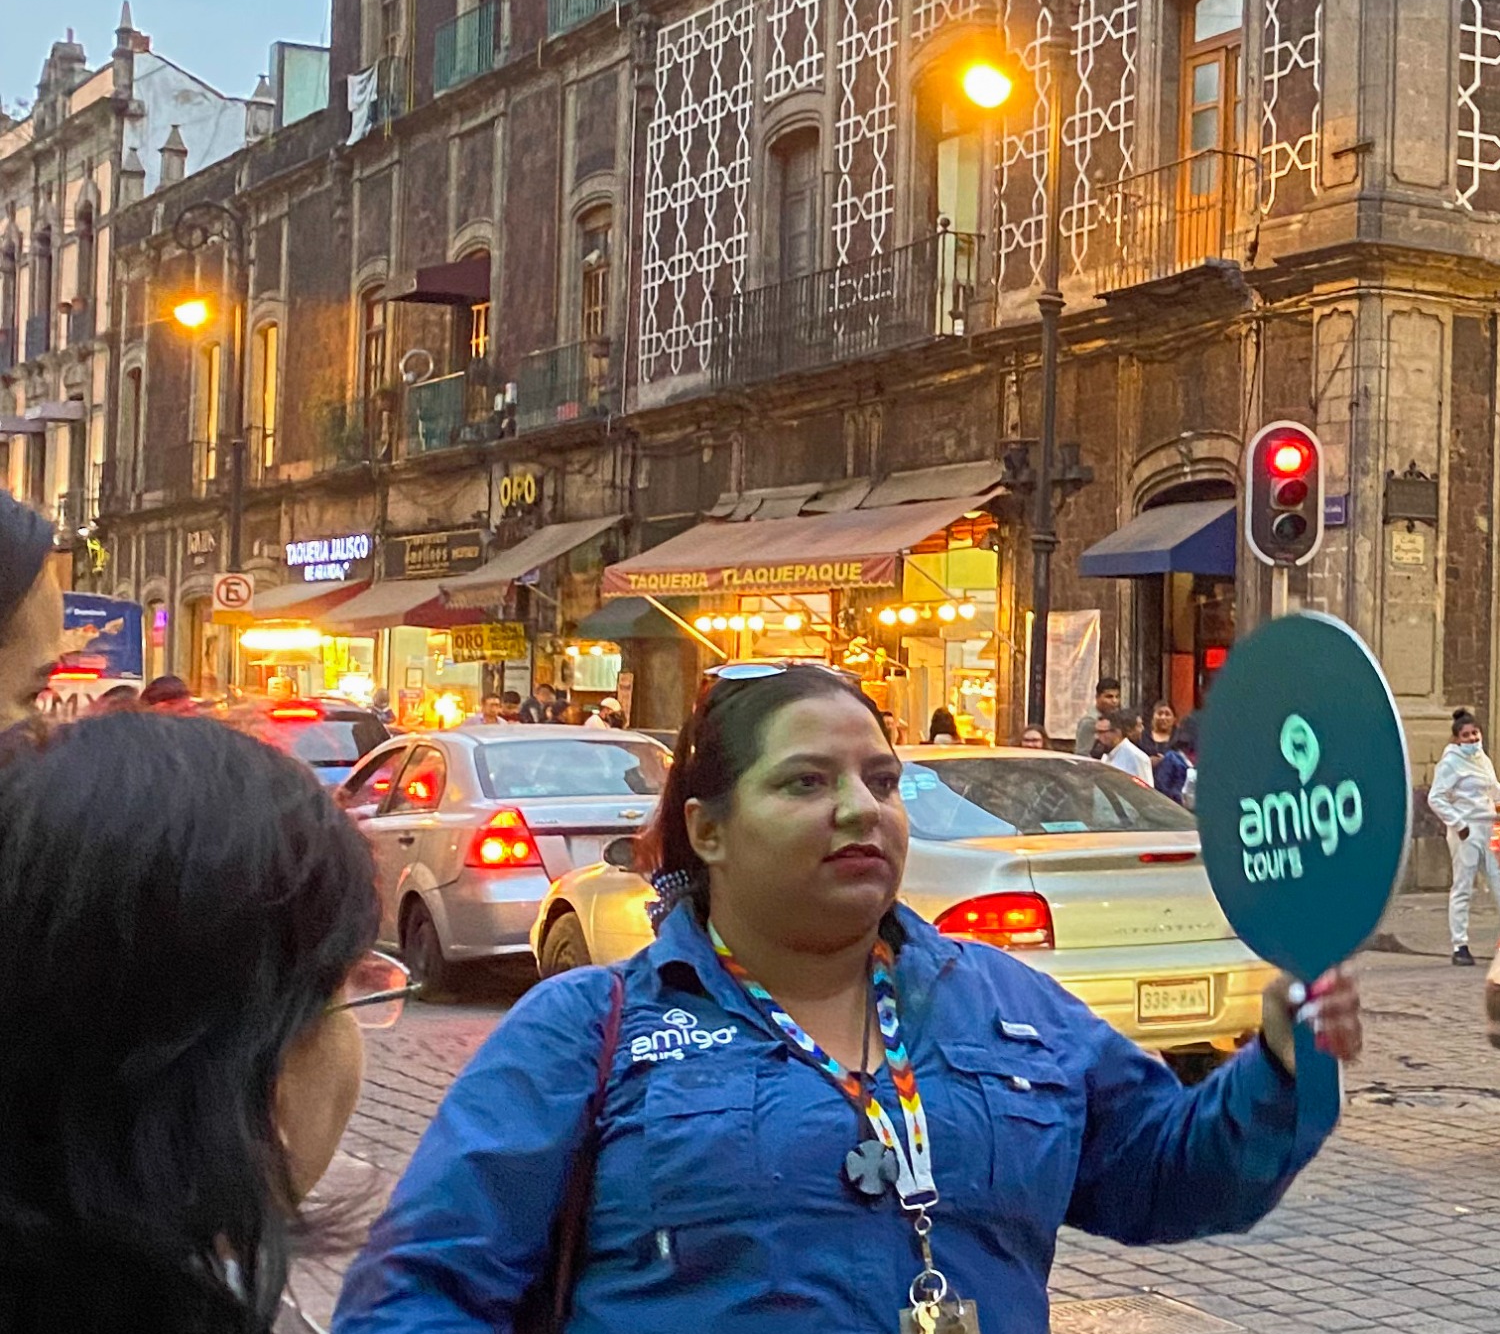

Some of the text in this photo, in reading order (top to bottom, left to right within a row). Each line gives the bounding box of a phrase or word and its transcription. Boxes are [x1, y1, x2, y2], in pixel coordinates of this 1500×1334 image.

[500, 473, 536, 508] ORO
[329, 533, 369, 561] JALISCO
[627, 562, 863, 590] TAQUERIA TLAQUEPAQUE
[454, 632, 484, 649] ORO
[1238, 779, 1364, 857] amigo
[630, 1027, 733, 1055] amigo
